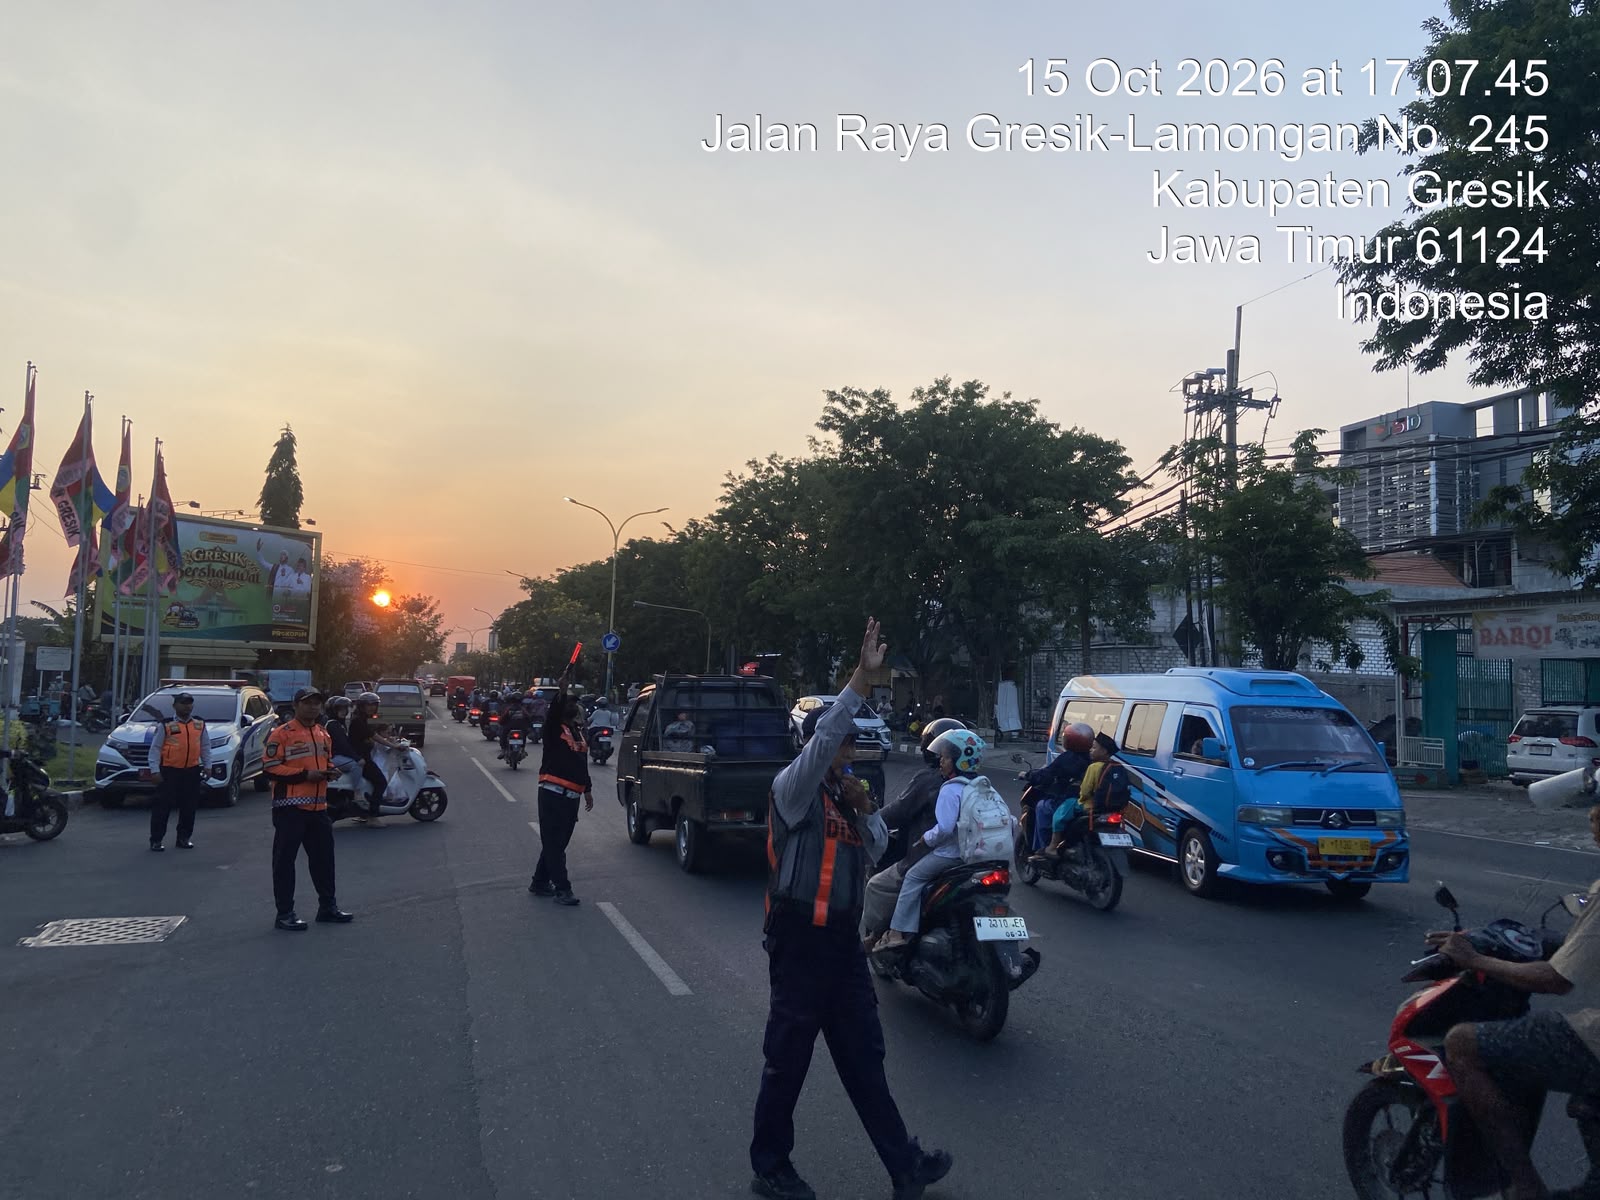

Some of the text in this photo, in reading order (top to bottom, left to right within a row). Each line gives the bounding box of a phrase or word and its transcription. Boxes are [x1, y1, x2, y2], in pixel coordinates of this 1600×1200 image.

[57, 500, 80, 539] GRESIK
[192, 547, 247, 567] GRESIK
[976, 919, 982, 928] W
